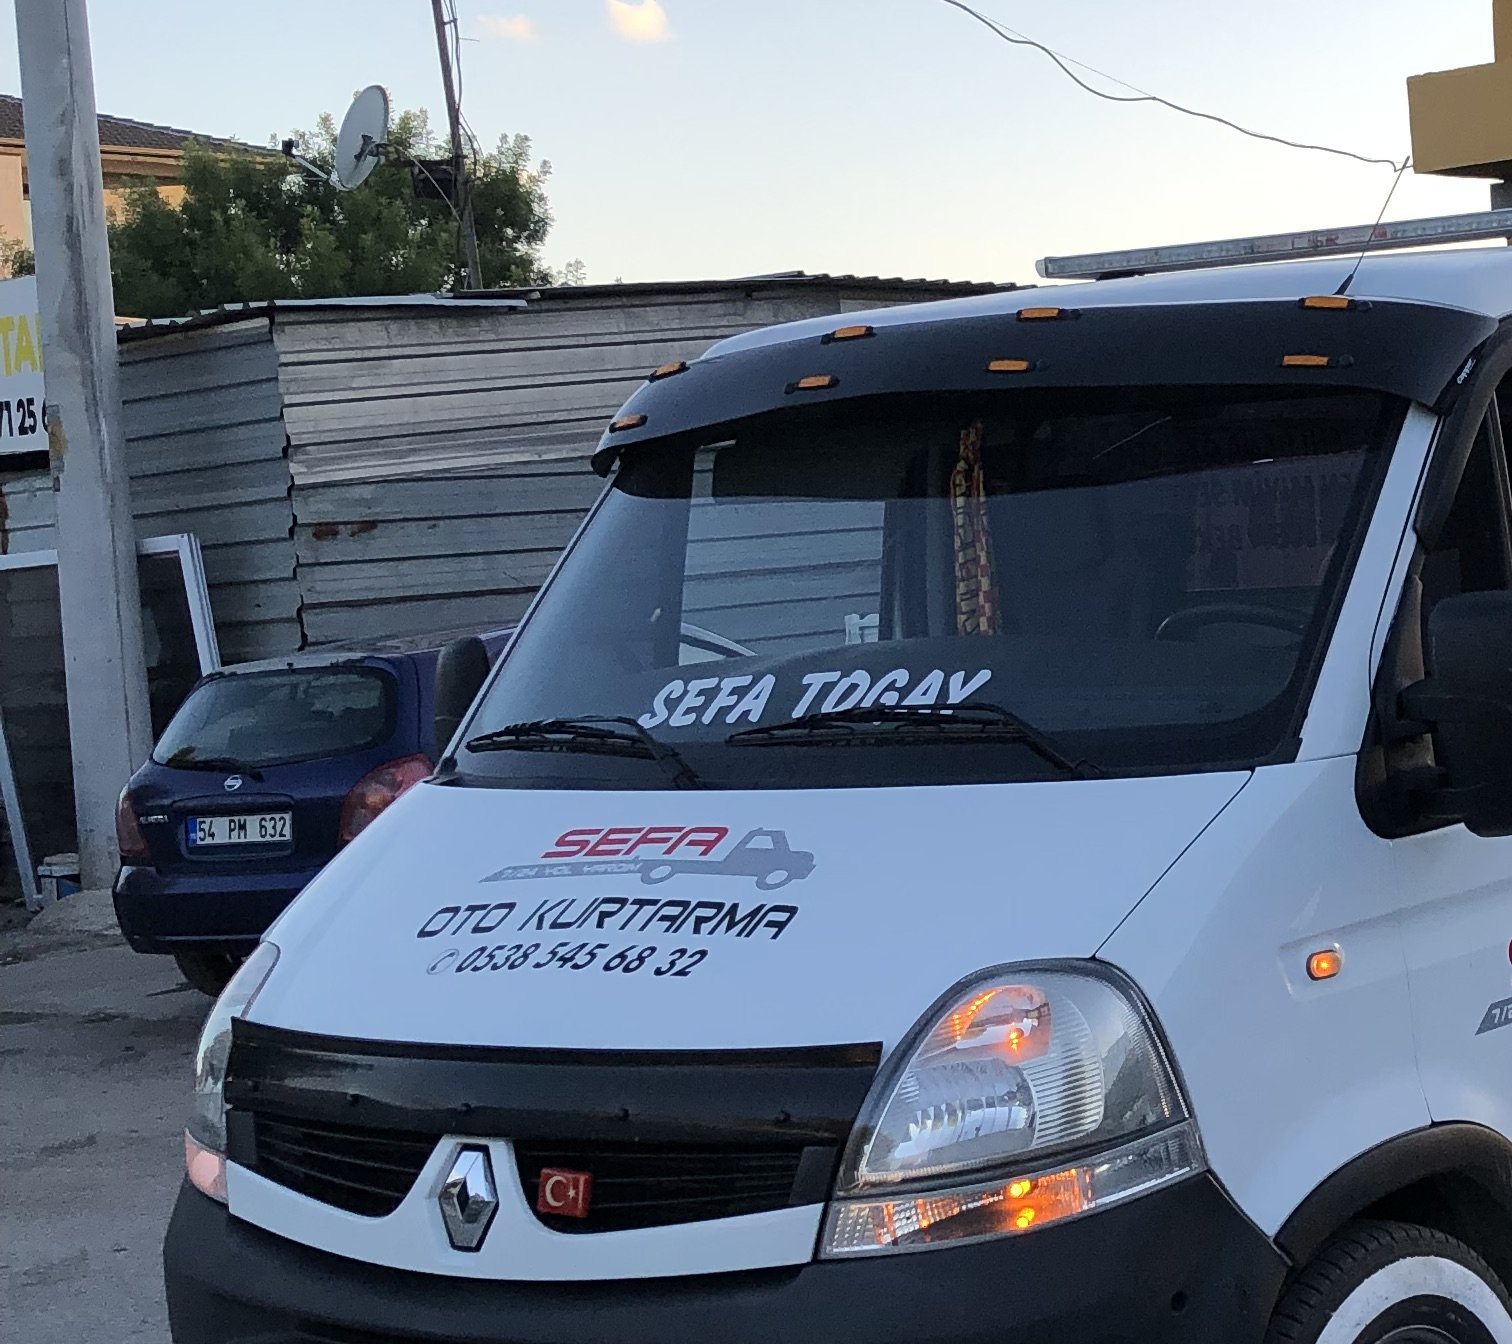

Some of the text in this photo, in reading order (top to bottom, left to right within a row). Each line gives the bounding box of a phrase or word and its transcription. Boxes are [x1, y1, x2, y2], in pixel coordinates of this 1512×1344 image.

[17, 397, 38, 437] 25
[636, 673, 776, 730] SEFA
[198, 816, 287, 842] 54 PM 632
[540, 825, 730, 859] SEFA
[416, 896, 800, 941] OTO KURTARMA
[454, 941, 709, 977] 0538 545 68 32
